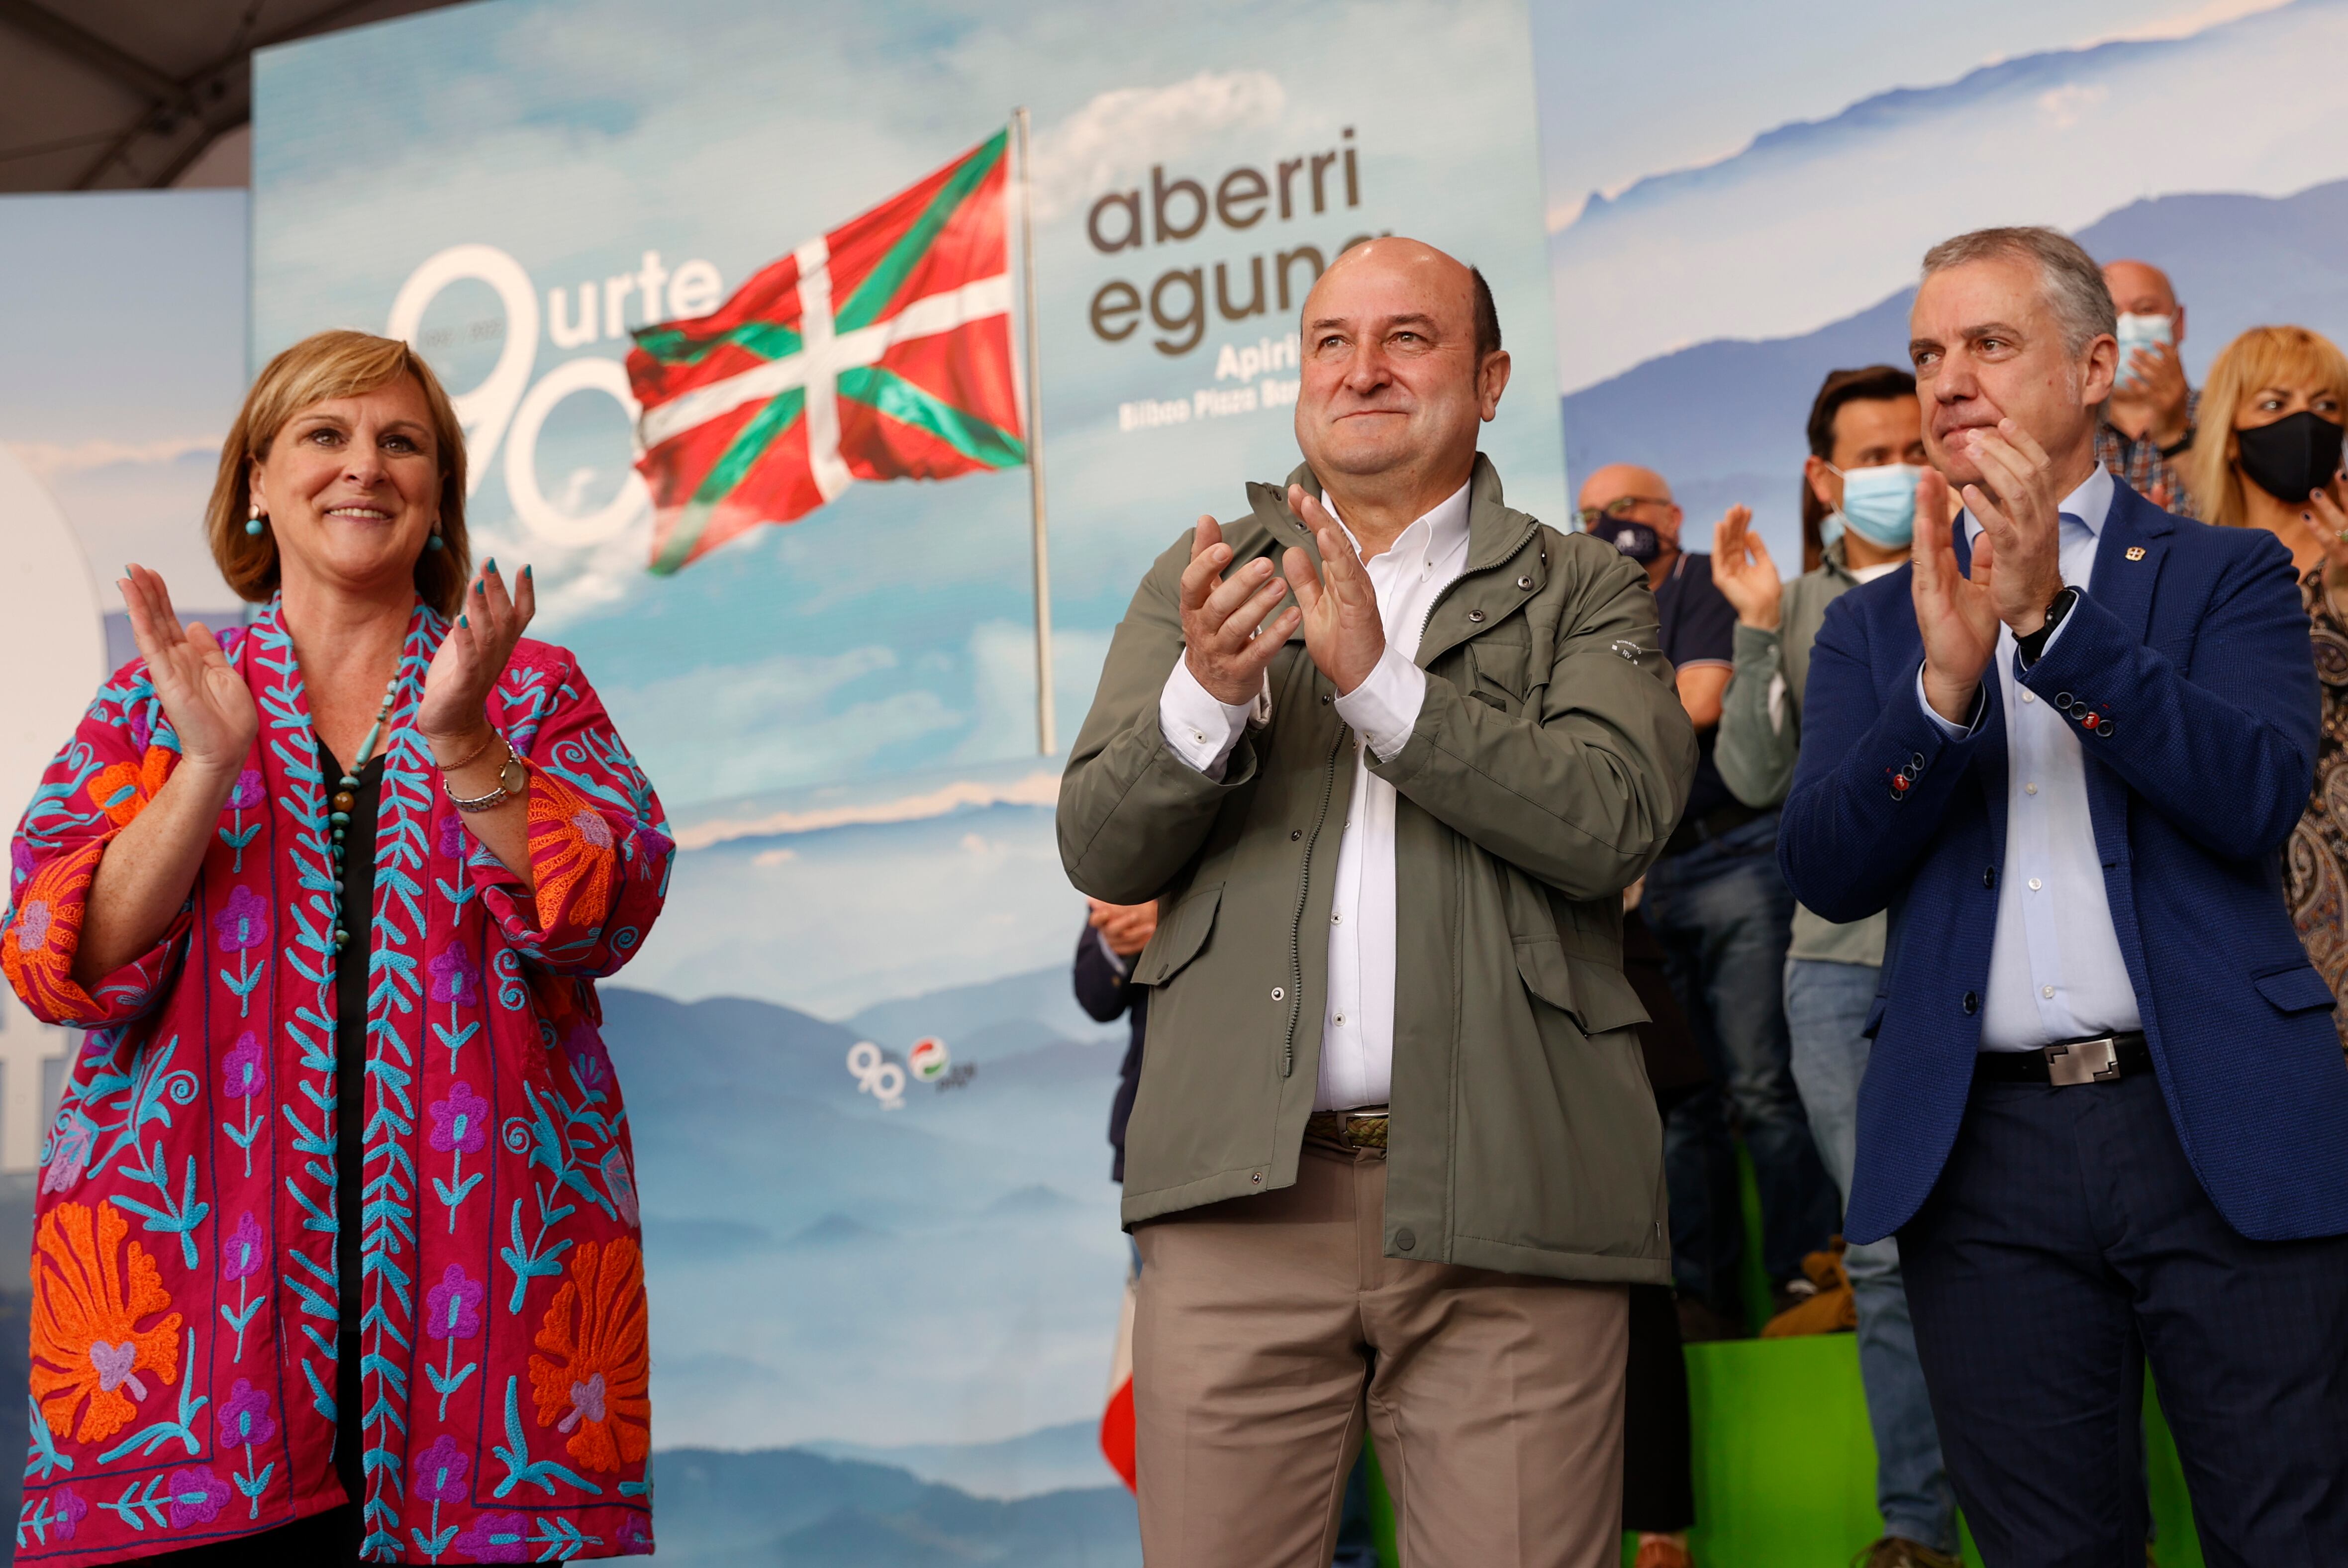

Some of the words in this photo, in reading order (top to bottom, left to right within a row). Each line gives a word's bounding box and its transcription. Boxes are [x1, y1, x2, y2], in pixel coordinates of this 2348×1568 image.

[1086, 127, 1360, 254] aberri
[549, 250, 722, 349] urte
[1088, 231, 1393, 358] egun
[1616, 640, 1642, 655] ROBERTO
[1622, 649, 1632, 659] RV
[847, 1041, 905, 1099] 90
